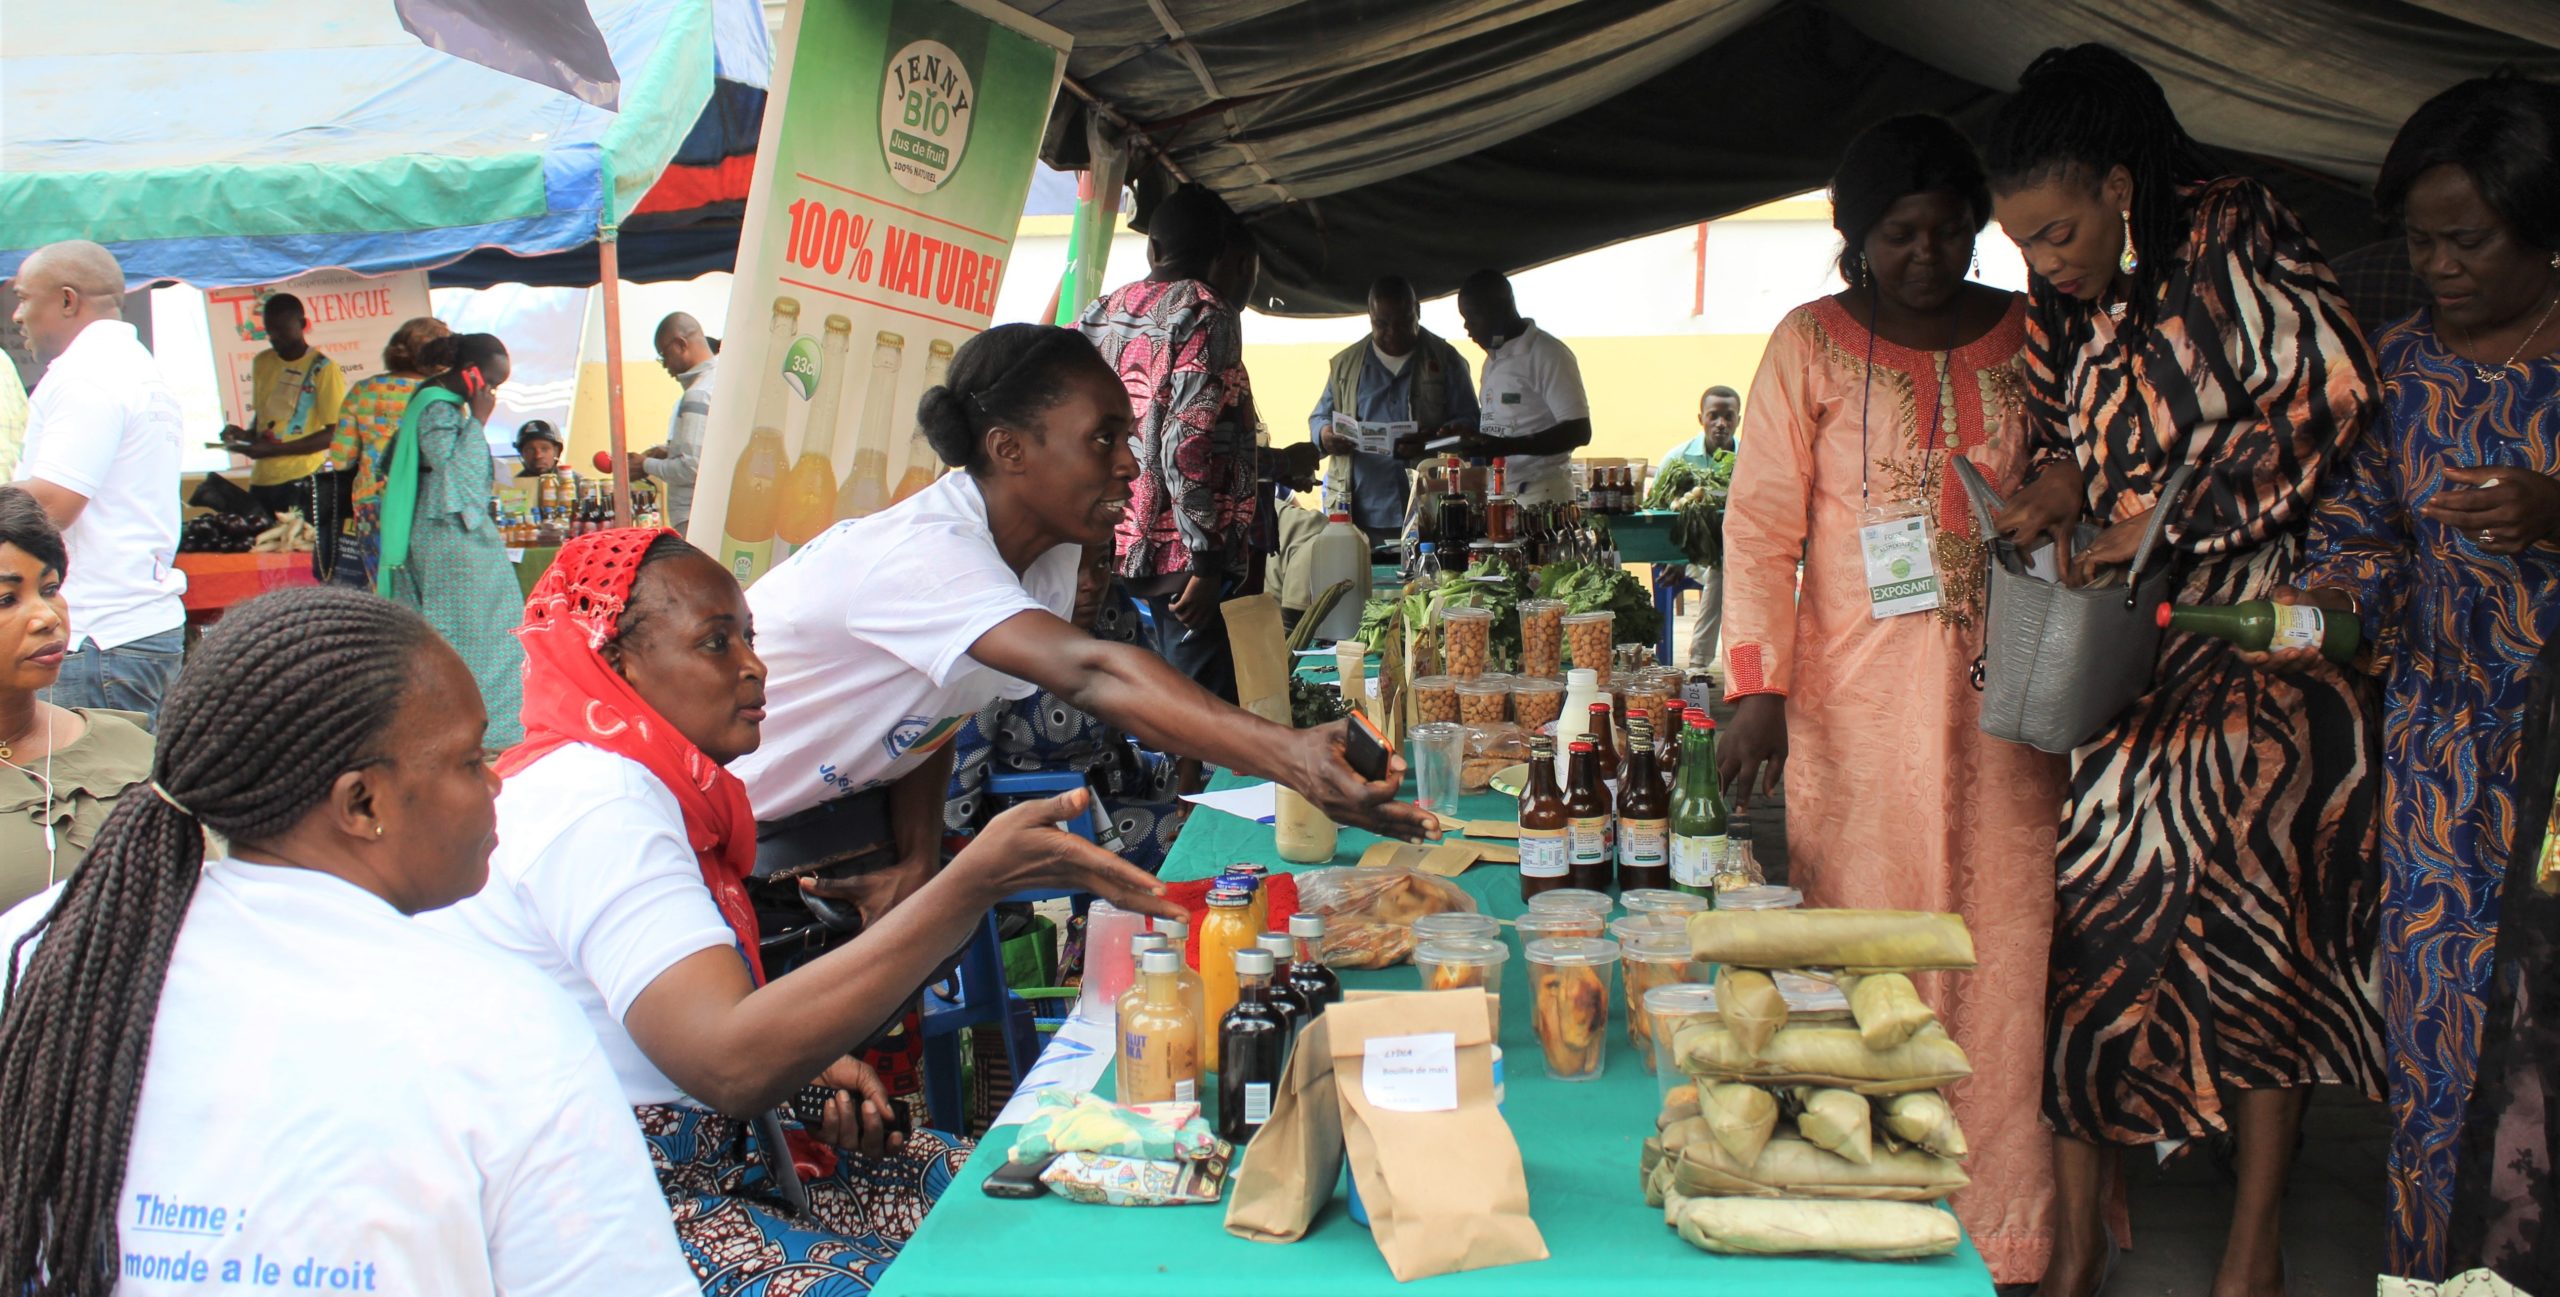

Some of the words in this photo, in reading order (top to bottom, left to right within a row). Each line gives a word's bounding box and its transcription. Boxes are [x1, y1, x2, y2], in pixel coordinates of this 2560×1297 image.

[894, 54, 969, 117] JENNY
[903, 88, 949, 137] BIO
[891, 133, 910, 151] Jus
[912, 141, 925, 157] de
[926, 145, 946, 165] fruit
[894, 161, 913, 175] 100%
[914, 166, 937, 183] NATUREL
[786, 198, 873, 283] 100%
[1872, 579, 1931, 600] EXPOSANT
[136, 1193, 227, 1232] Thème
[124, 1250, 209, 1283] monde
[221, 1258, 242, 1283] a
[252, 1253, 281, 1285] le
[292, 1256, 376, 1291] droit
